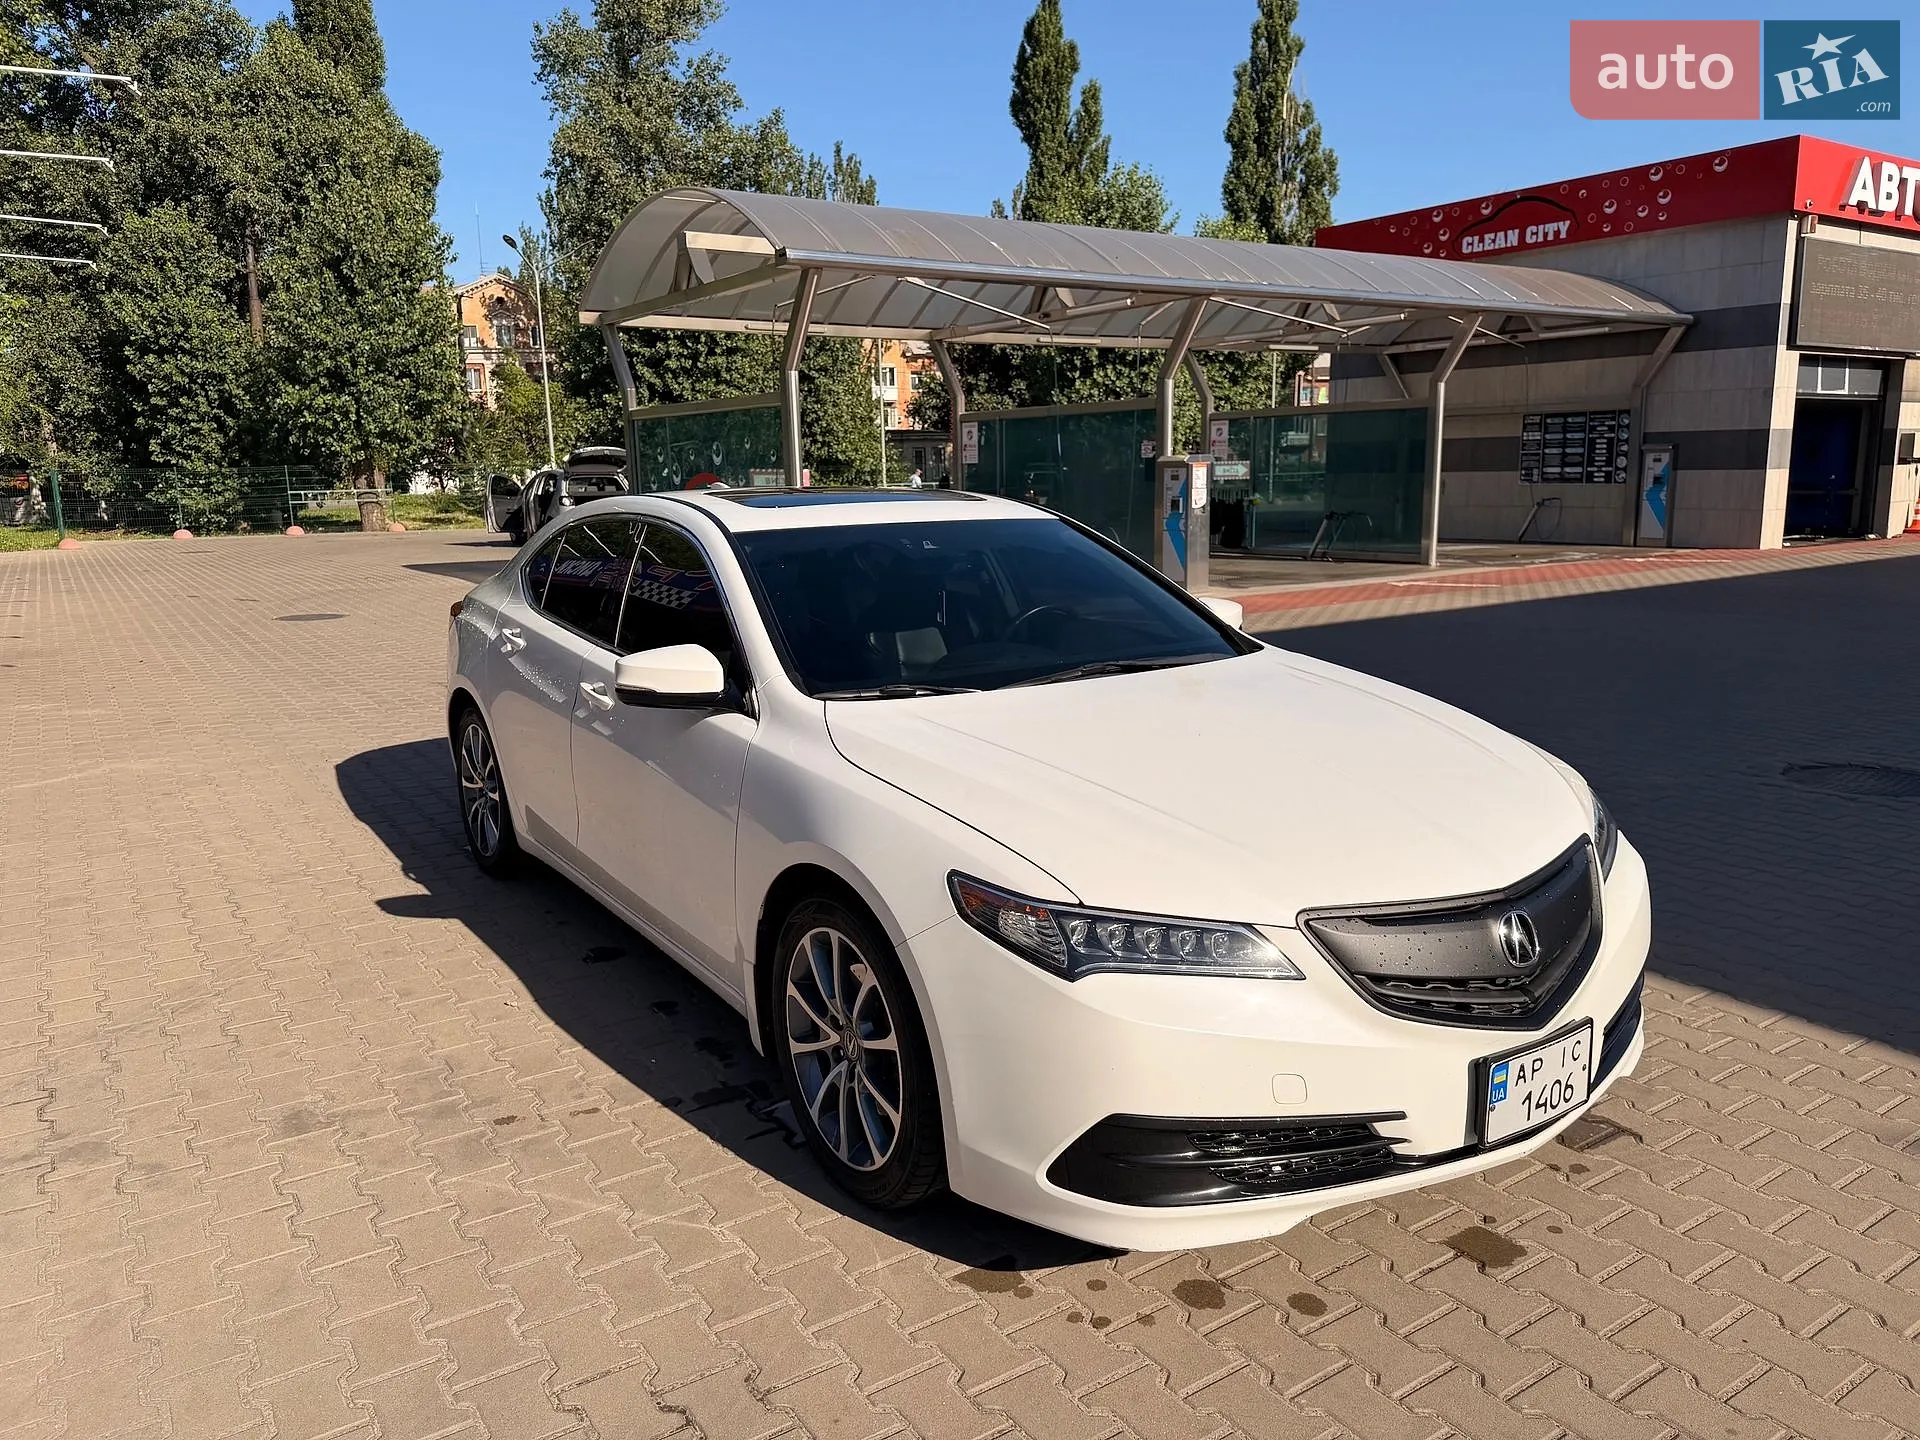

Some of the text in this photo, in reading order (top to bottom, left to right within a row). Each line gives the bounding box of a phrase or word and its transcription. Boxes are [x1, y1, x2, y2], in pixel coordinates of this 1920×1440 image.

[1461, 220, 1571, 254] CLEAN CITY
[1514, 1040, 1581, 1087] AP IC
[1491, 1089, 1505, 1102] UA
[1521, 1071, 1574, 1122] 1406
